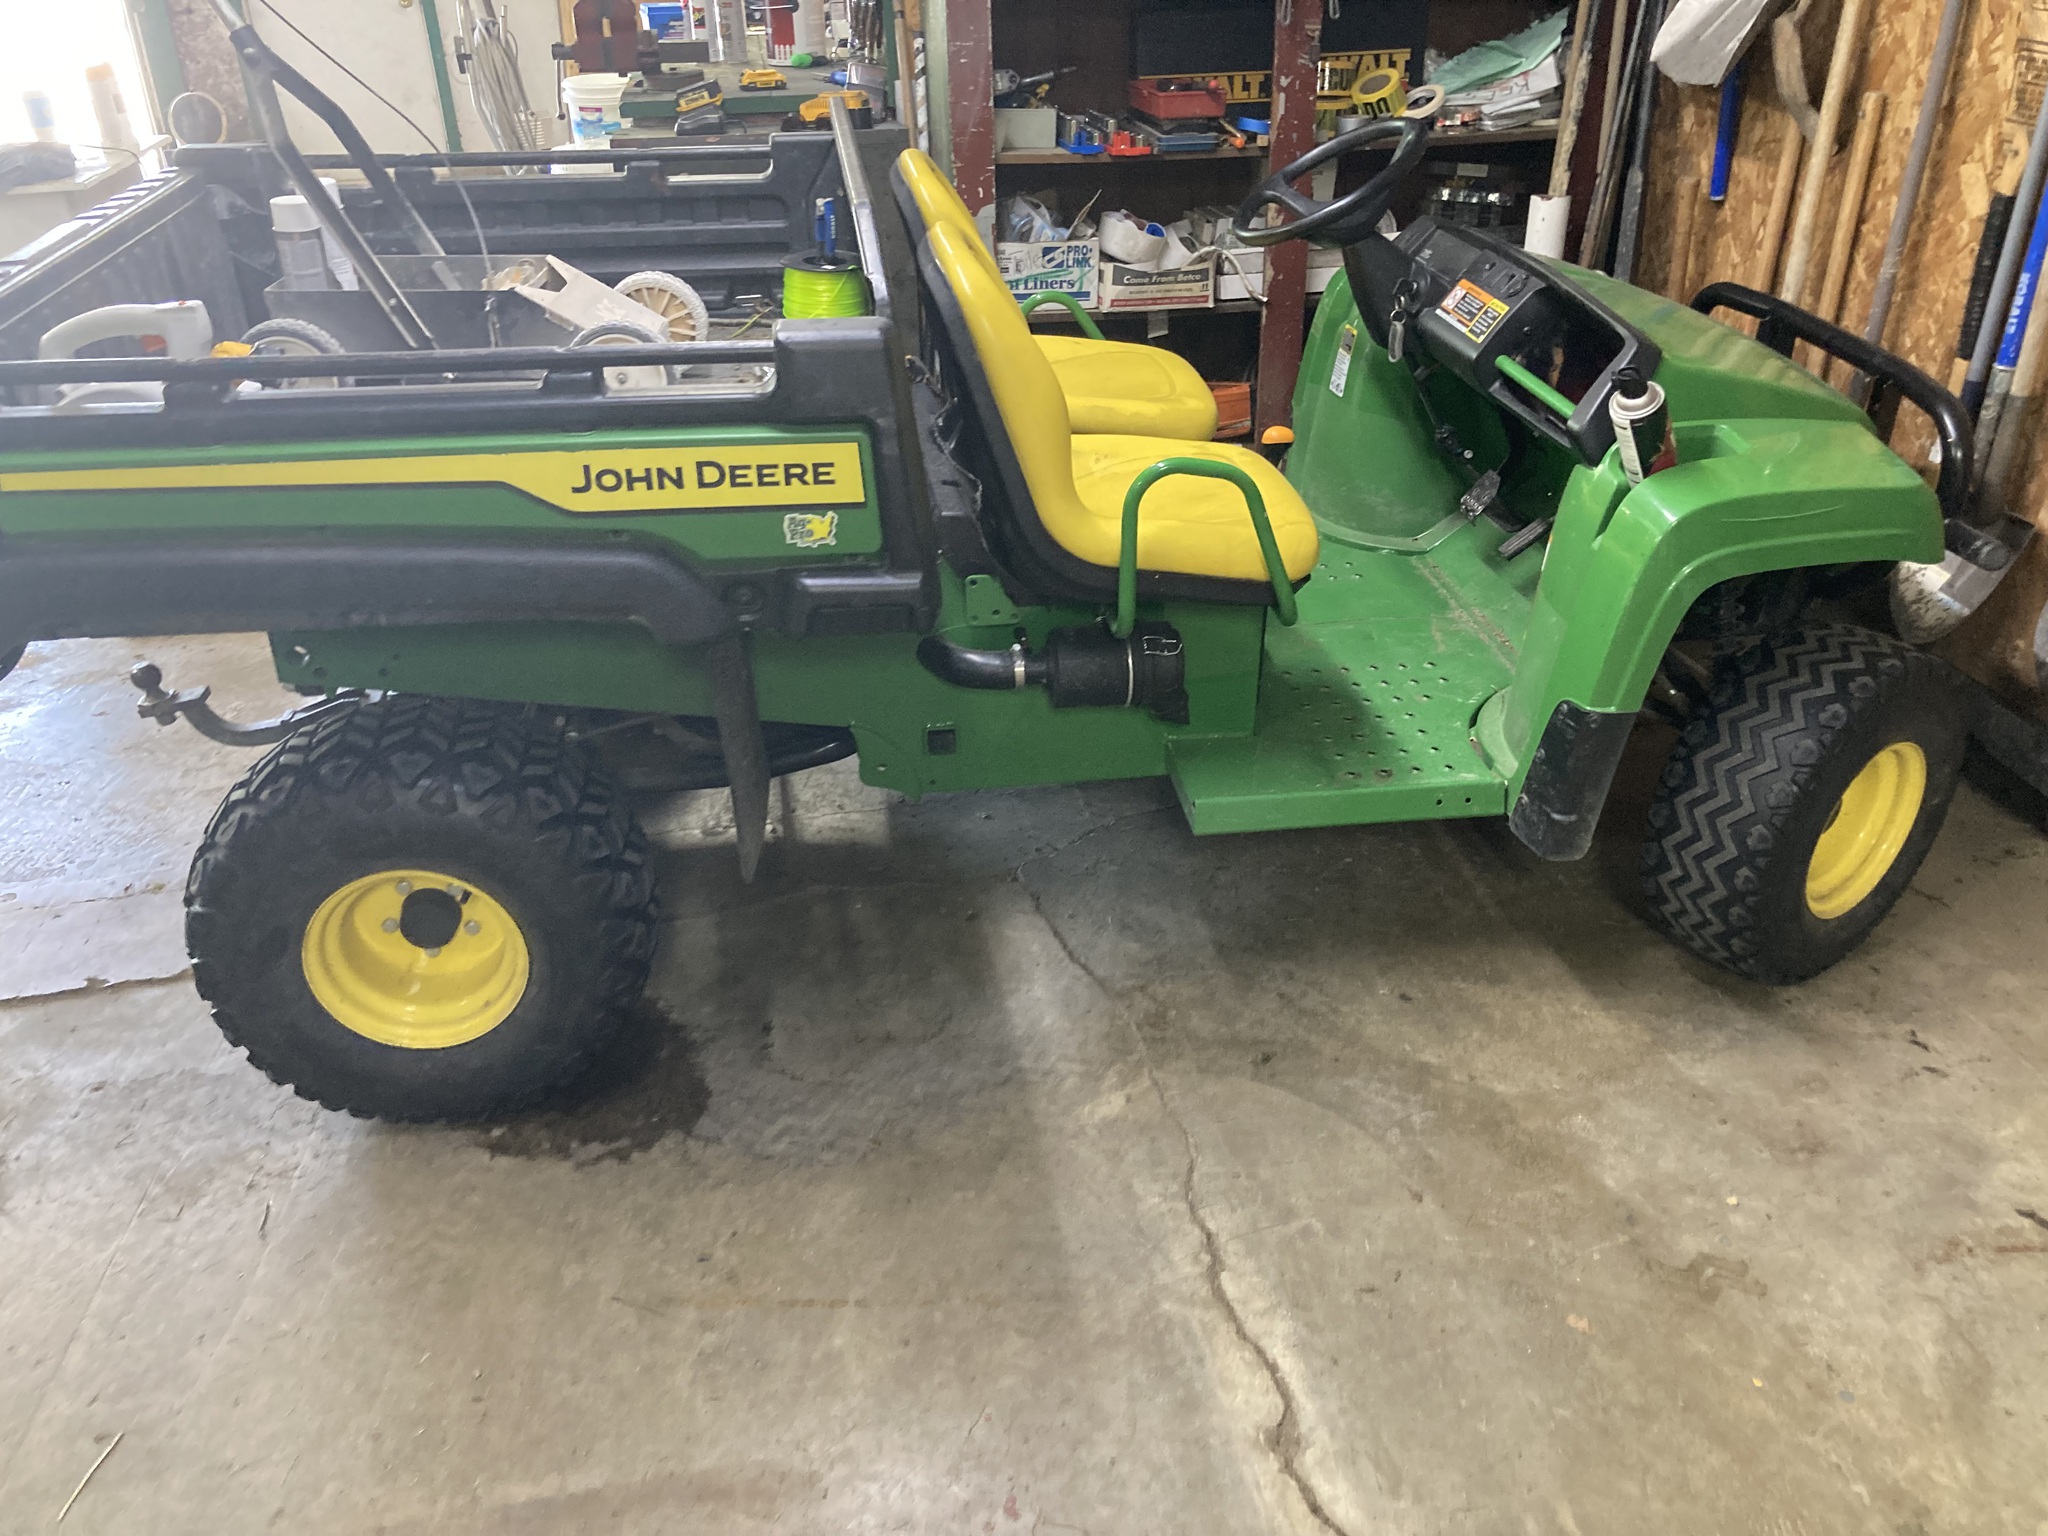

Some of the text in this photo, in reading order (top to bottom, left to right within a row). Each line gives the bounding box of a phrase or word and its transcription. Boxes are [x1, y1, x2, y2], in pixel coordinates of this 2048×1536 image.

[1024, 277, 1075, 290] Liners
[1151, 275, 1175, 283] From
[571, 460, 836, 494] JOHN DEERE
